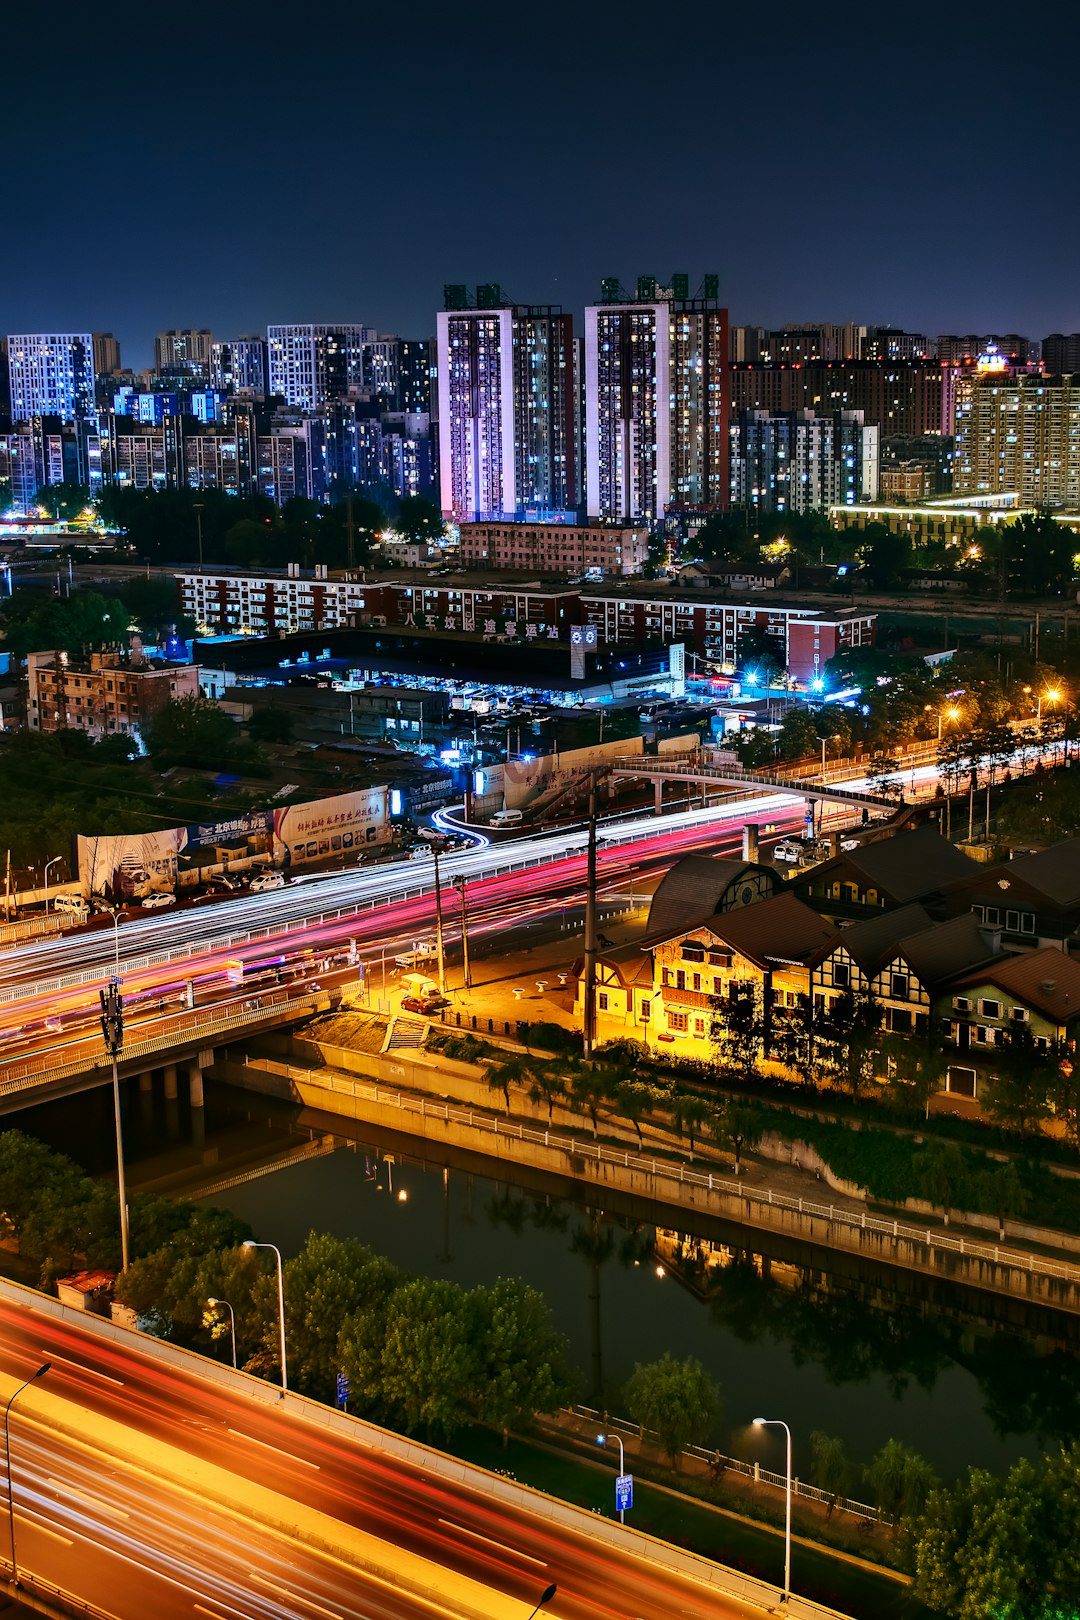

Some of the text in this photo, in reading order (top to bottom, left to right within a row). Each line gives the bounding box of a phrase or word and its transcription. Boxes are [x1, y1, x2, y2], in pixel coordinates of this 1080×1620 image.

[404, 612, 559, 639] 八王坟长途客运站
